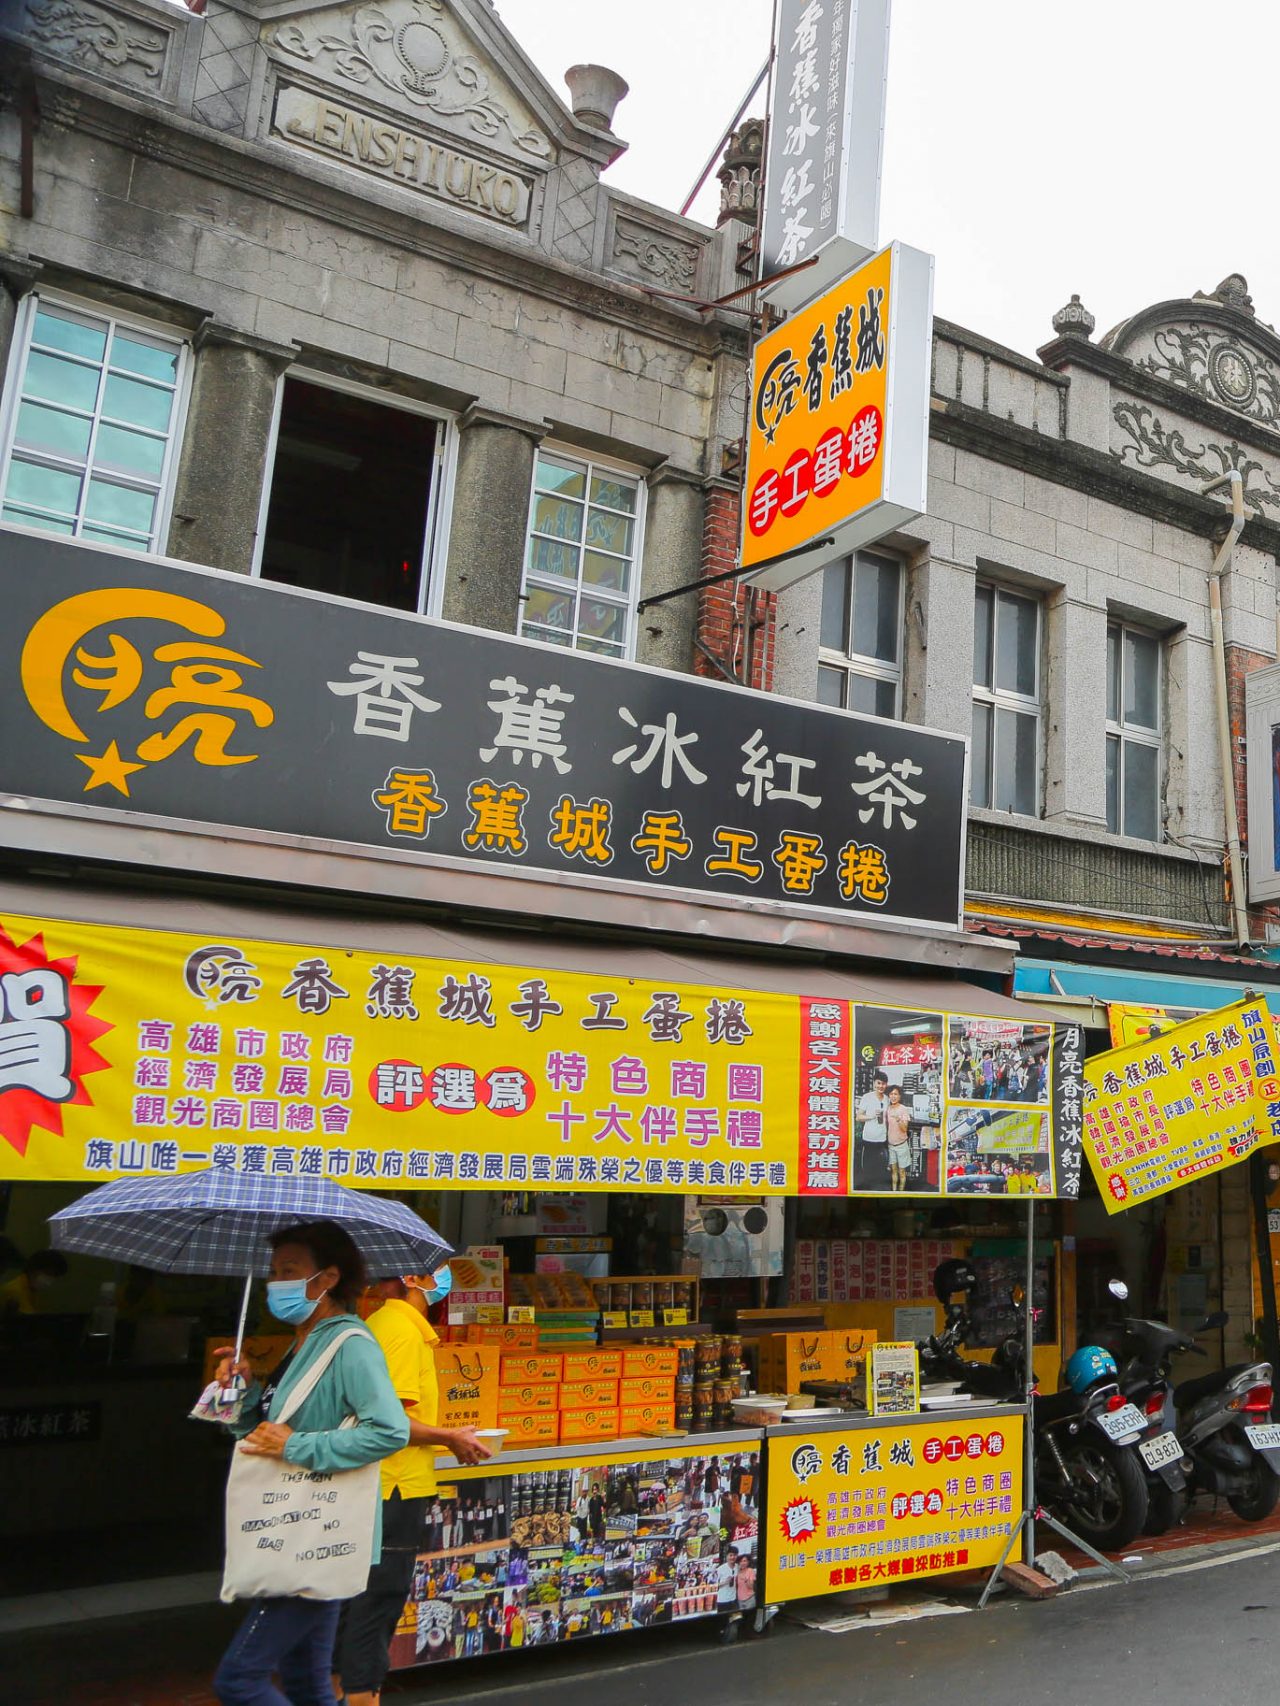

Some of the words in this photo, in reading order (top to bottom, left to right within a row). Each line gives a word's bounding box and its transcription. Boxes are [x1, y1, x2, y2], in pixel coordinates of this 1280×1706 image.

[774, 0, 824, 266] 香蕉冰紅茶
[754, 410, 878, 528] 手工蛋捲
[326, 648, 927, 832] 香蕉冰紅茶
[372, 766, 891, 906] 香蕉城手工蛋捲
[283, 957, 752, 1046] 香蕉城手工蛋捲
[138, 1019, 355, 1063] 高雄市政府
[136, 1057, 353, 1100] 經濟發展局
[546, 1051, 764, 1103] 特色商圈
[807, 1003, 842, 1188] 感謝各大媒體採訪推薦
[1190, 1058, 1252, 1096] 特色商圈
[133, 1095, 352, 1135] 觀光商圈總會
[546, 1101, 764, 1149] 十大伴手禮
[1056, 1027, 1083, 1196] 月亮香蕉冰紅茶
[1083, 1088, 1154, 1126] 高雄市政府
[1100, 1132, 1170, 1170] 觀光商圈總會
[831, 1439, 915, 1475] 香蕉城
[925, 1433, 1003, 1462] 手工蛋捲
[1144, 1439, 1182, 1466] CL9-837
[263, 1491, 290, 1504] WHO
[827, 1486, 888, 1505] 高雄市政府
[946, 1471, 1012, 1497] 特色商圈
[241, 1507, 321, 1533] IMAGINATION
[323, 1519, 340, 1532] NO
[786, 1501, 815, 1538] 賀
[826, 1502, 887, 1522] 經濟發展局
[946, 1495, 1012, 1521] 十大伴手禮
[825, 1518, 886, 1539] 觀光商圈總會
[295, 1549, 315, 1563] NO
[829, 1548, 969, 1586] 感謝各大媒體採訪推薦
